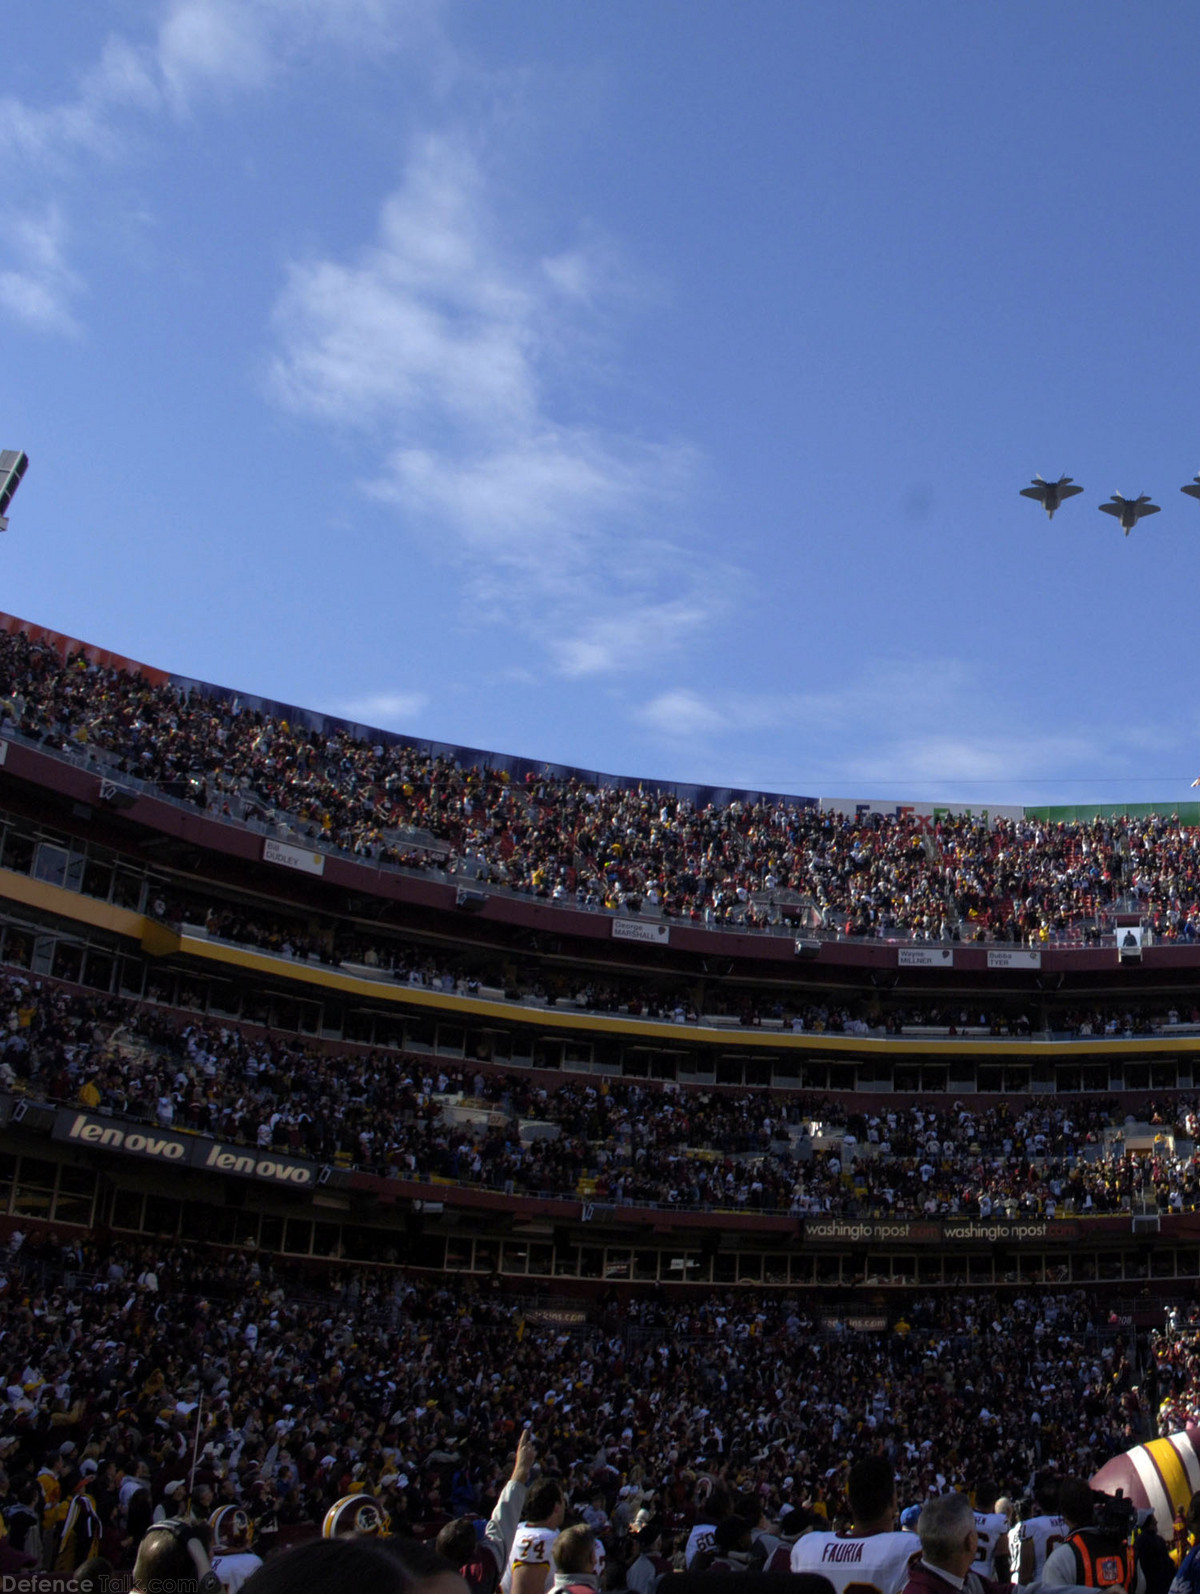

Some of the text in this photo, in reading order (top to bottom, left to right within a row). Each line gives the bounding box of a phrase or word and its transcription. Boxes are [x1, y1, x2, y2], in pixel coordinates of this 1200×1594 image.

[615, 929, 655, 940] MARSHALL
[69, 1114, 185, 1160] lenovo
[205, 1144, 311, 1184] lenovo
[521, 1538, 545, 1560] 74
[821, 1542, 865, 1563] FAURIA
